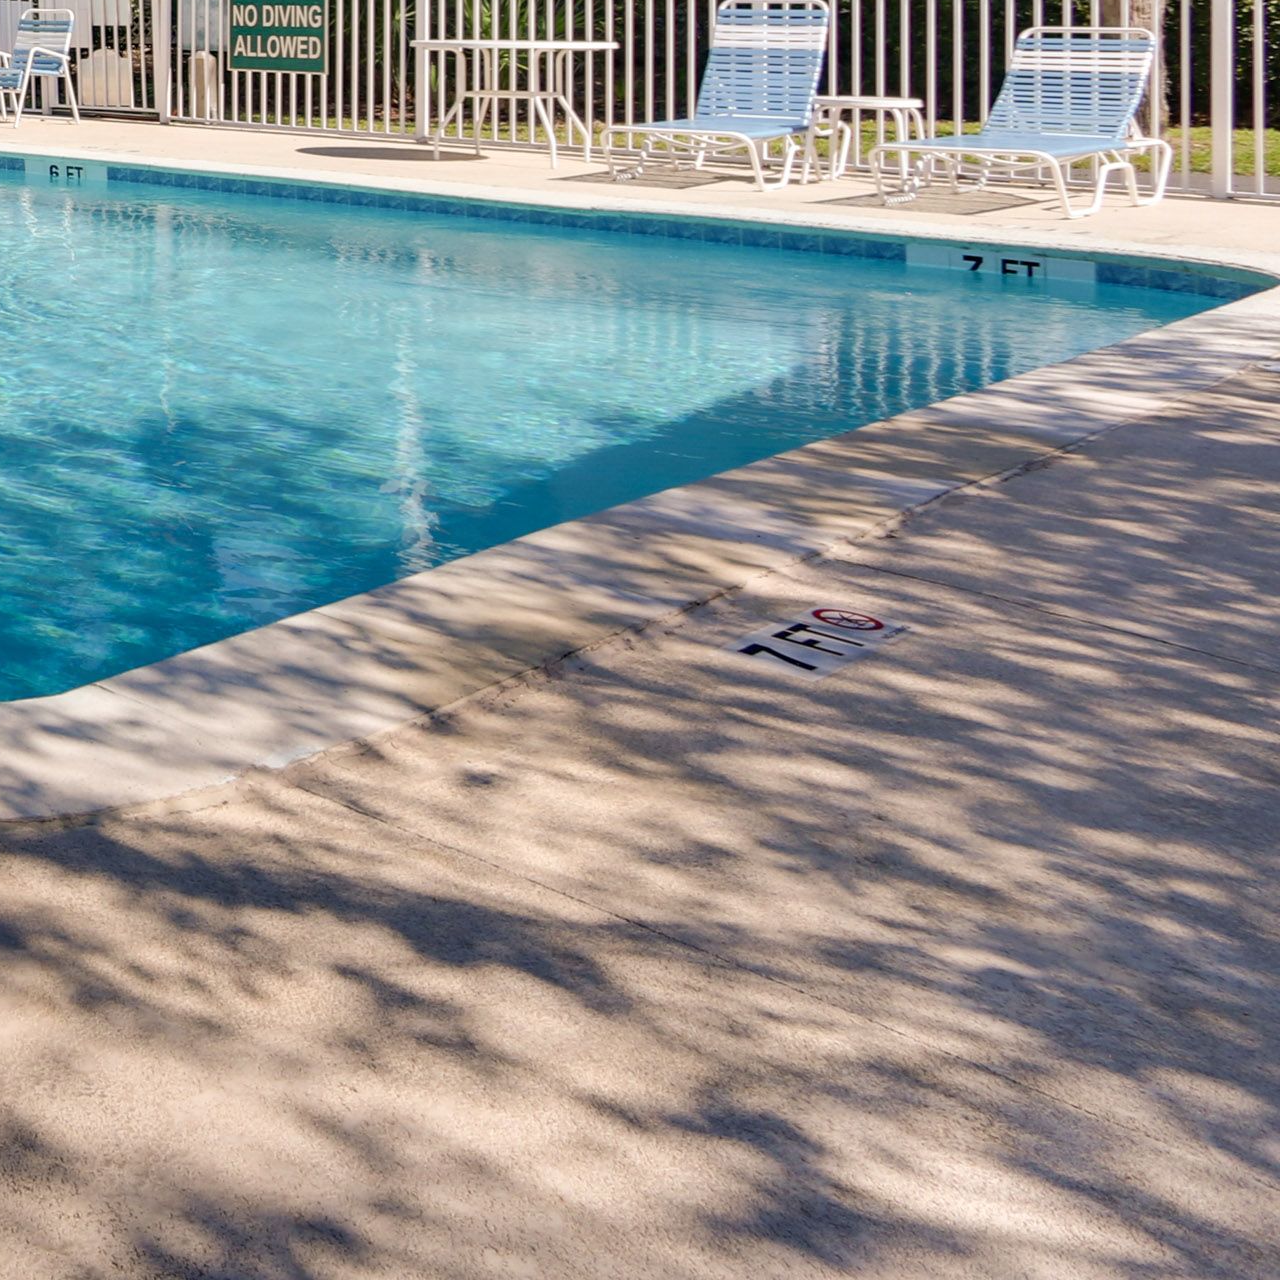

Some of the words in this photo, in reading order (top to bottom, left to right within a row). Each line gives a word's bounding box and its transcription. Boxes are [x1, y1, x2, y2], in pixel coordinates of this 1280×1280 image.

[232, 4, 258, 28] NO
[262, 4, 322, 28] DIVING
[233, 35, 321, 59] ALLOWED
[771, 622, 864, 656] FT
[737, 643, 819, 671] 7
